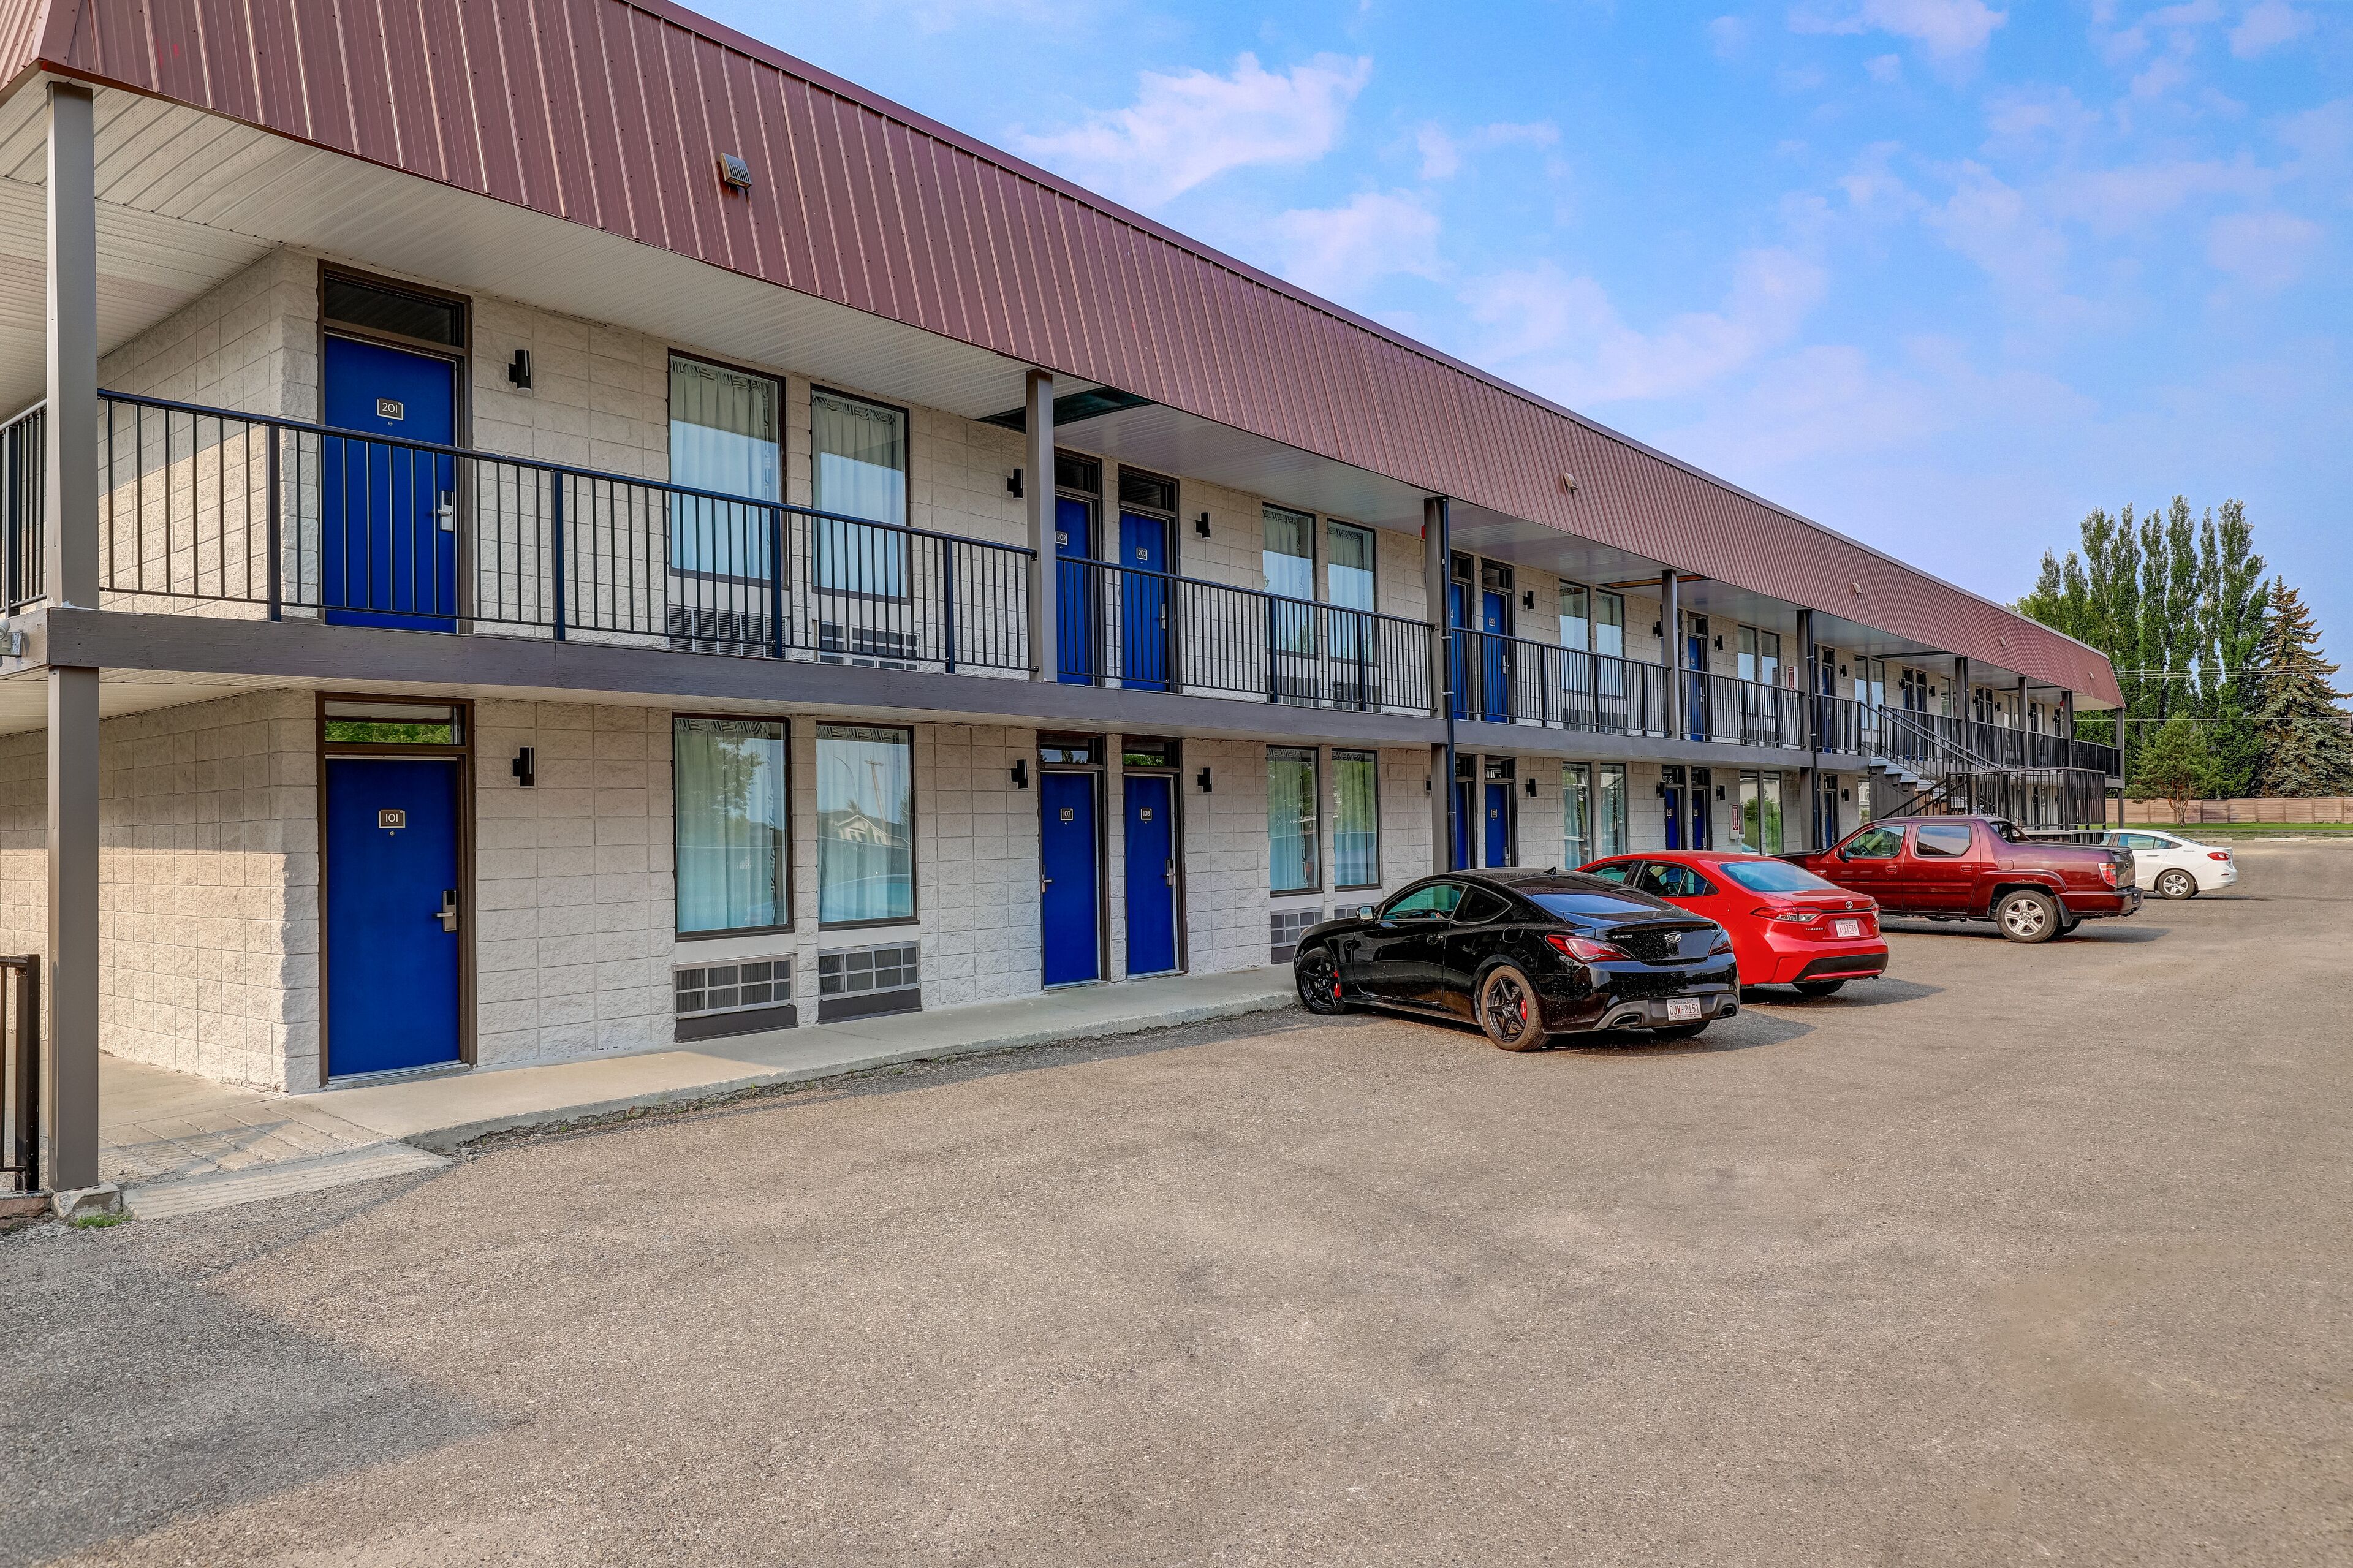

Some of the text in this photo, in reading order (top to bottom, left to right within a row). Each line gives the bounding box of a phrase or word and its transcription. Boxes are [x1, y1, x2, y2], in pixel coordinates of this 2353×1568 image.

[382, 402, 398, 414] 201
[385, 813, 398, 822] 101
[1669, 1004, 1700, 1015] CJW-2151
